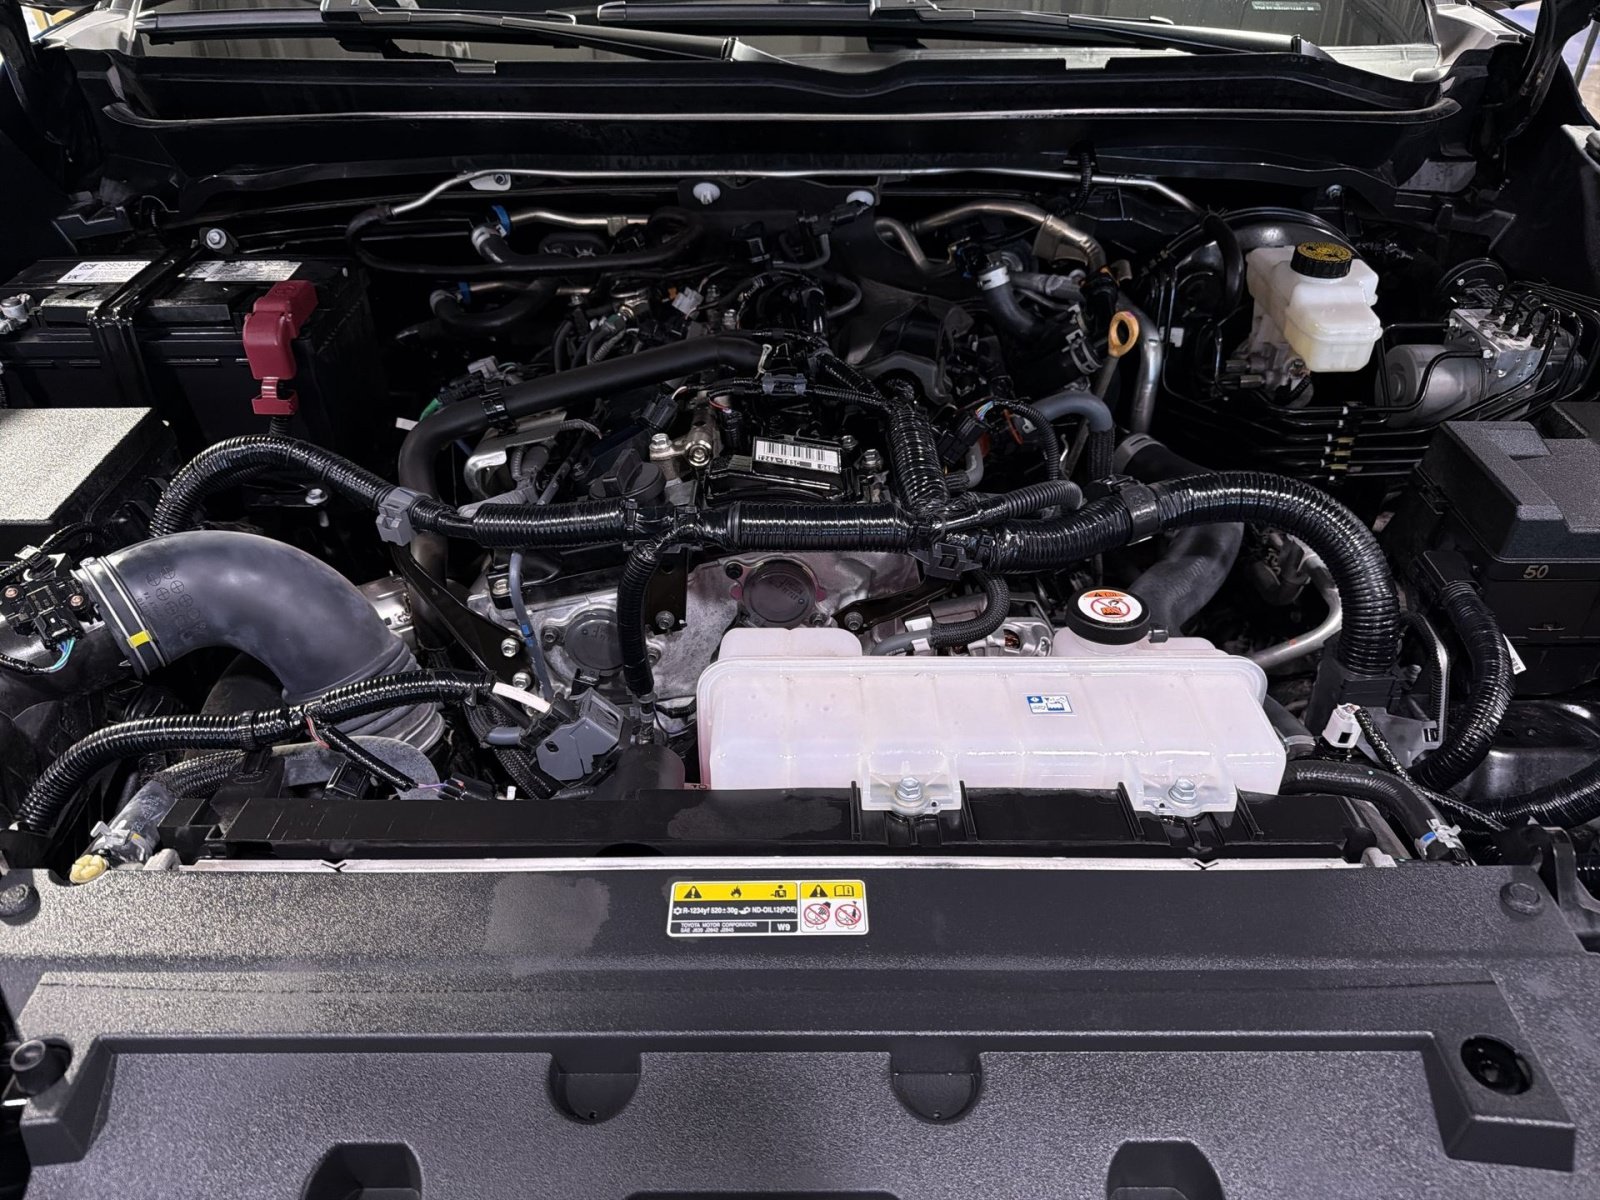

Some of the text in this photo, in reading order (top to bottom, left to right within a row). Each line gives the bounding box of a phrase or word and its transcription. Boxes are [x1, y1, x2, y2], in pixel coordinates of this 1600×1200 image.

[1523, 565, 1549, 579] 50
[682, 906, 797, 915] R-1234yf 520±30g ND-OIL12(POE)
[776, 923, 791, 931] W9
